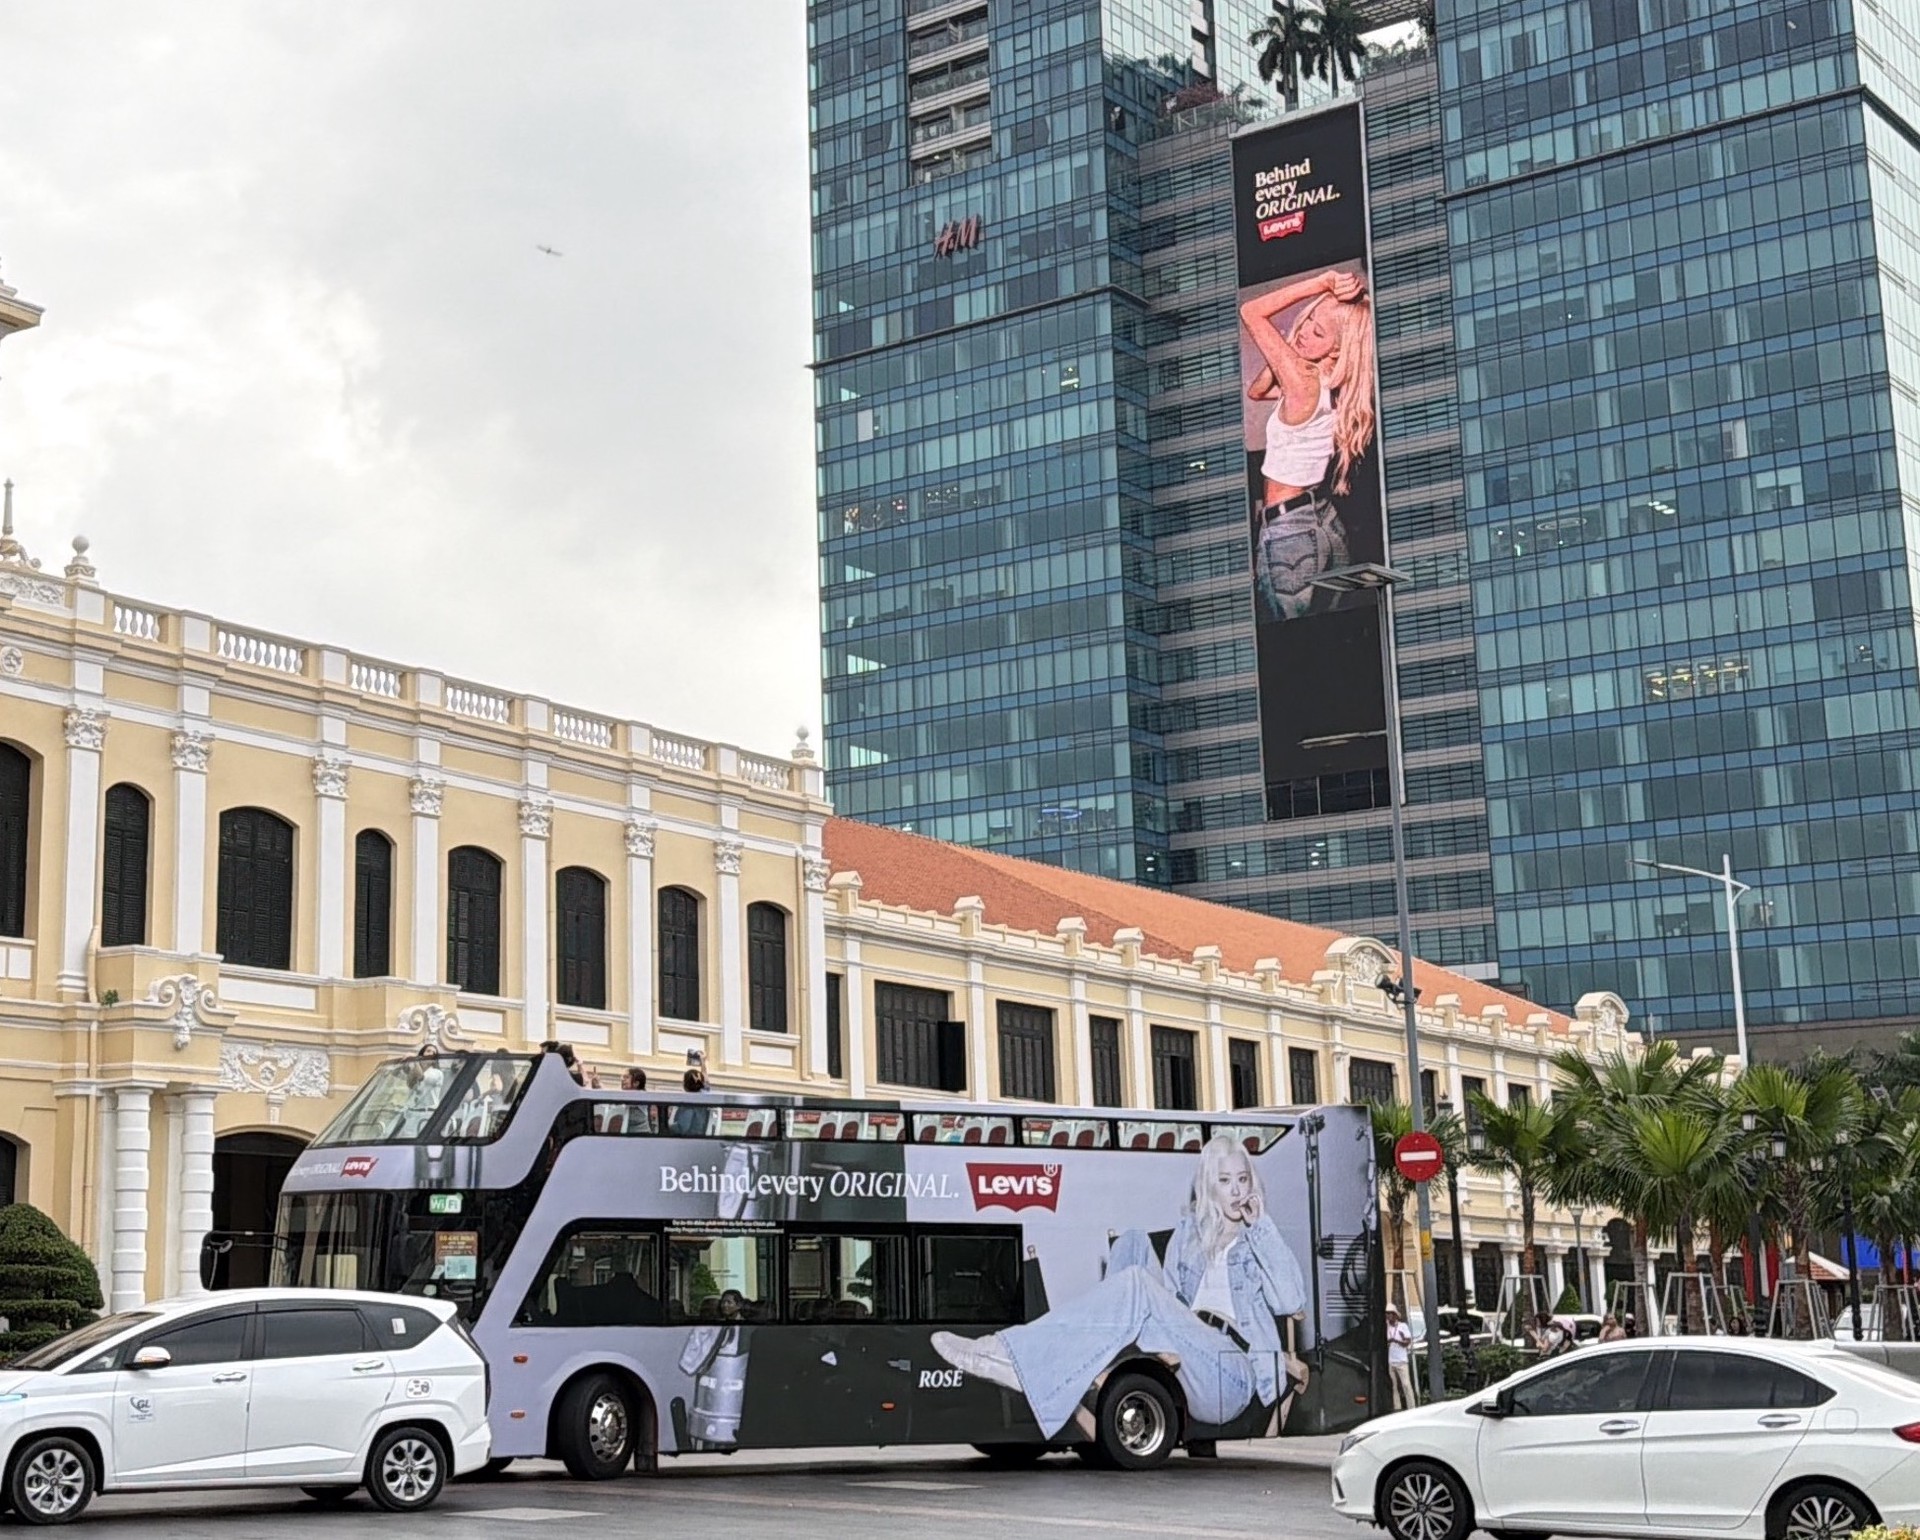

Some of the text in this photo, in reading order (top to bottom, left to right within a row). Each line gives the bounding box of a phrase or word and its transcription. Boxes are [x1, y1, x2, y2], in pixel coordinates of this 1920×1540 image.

[1255, 158, 1311, 187] Behind
[1255, 180, 1298, 202] every
[1256, 184, 1341, 219] ORIGINAL.
[934, 214, 981, 260] H&M
[659, 1165, 960, 1202] Behind every ORIGINAL.
